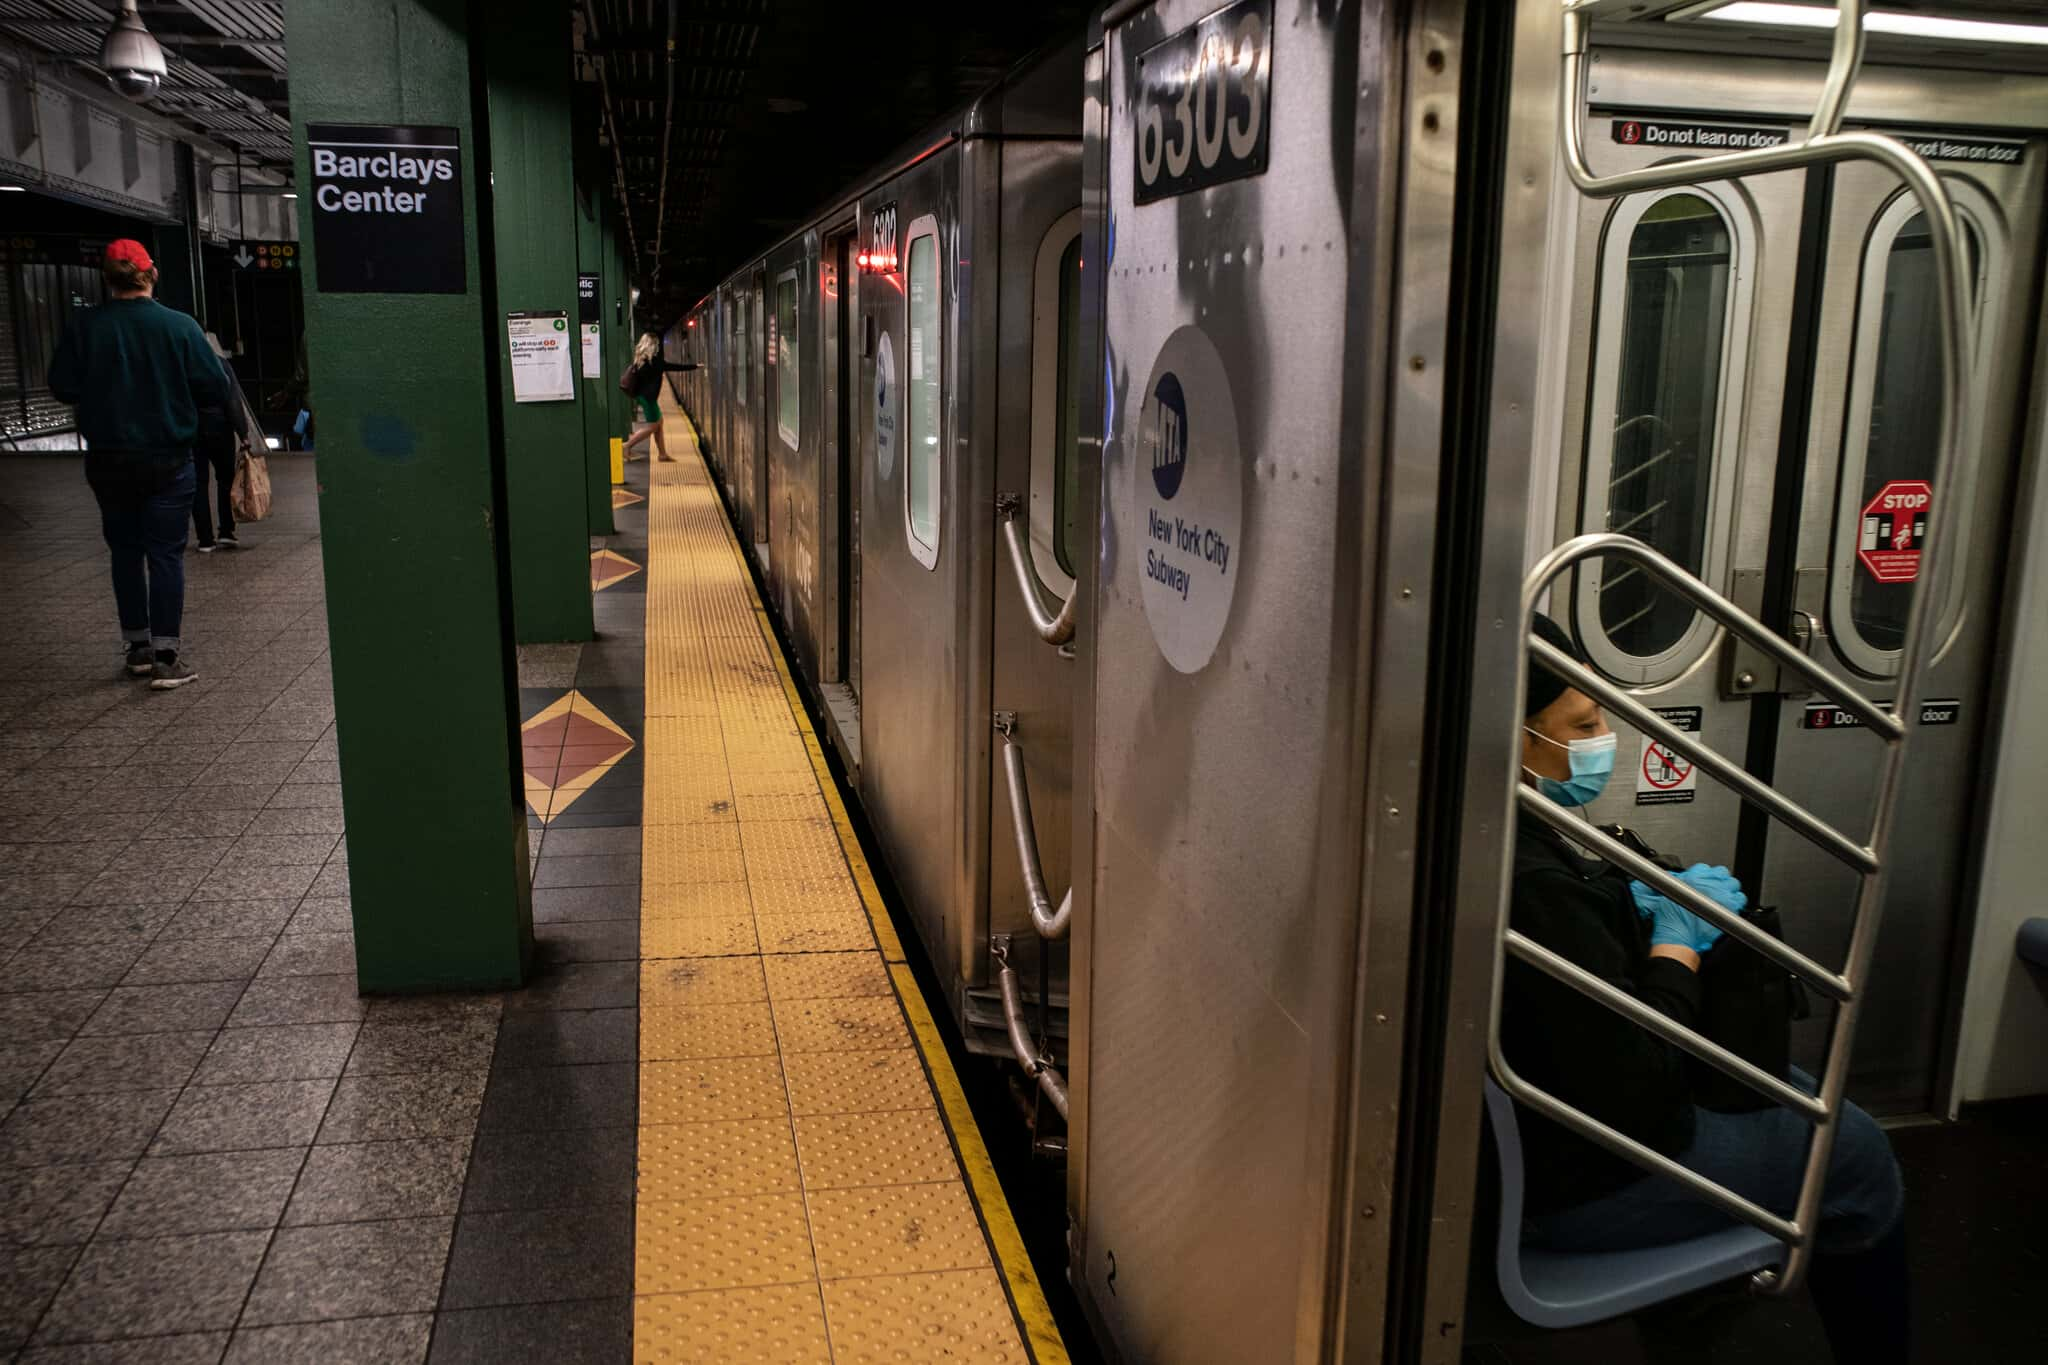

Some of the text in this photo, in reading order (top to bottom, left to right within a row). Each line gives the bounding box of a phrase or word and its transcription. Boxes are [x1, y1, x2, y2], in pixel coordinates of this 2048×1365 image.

[1137, 12, 1261, 186] 6303
[1646, 126, 1783, 148] Do not lean on door
[1914, 142, 1938, 156] not
[1938, 140, 1969, 158] lean
[1969, 147, 1988, 159] on
[1988, 145, 2019, 161] door
[314, 149, 453, 185] Barclays
[317, 184, 427, 213] Center
[873, 208, 897, 264] 6302
[1883, 494, 1928, 509] STOP
[1149, 508, 1229, 575] New York City
[1147, 548, 1190, 601] Subway
[1834, 709, 1952, 725] Do door
